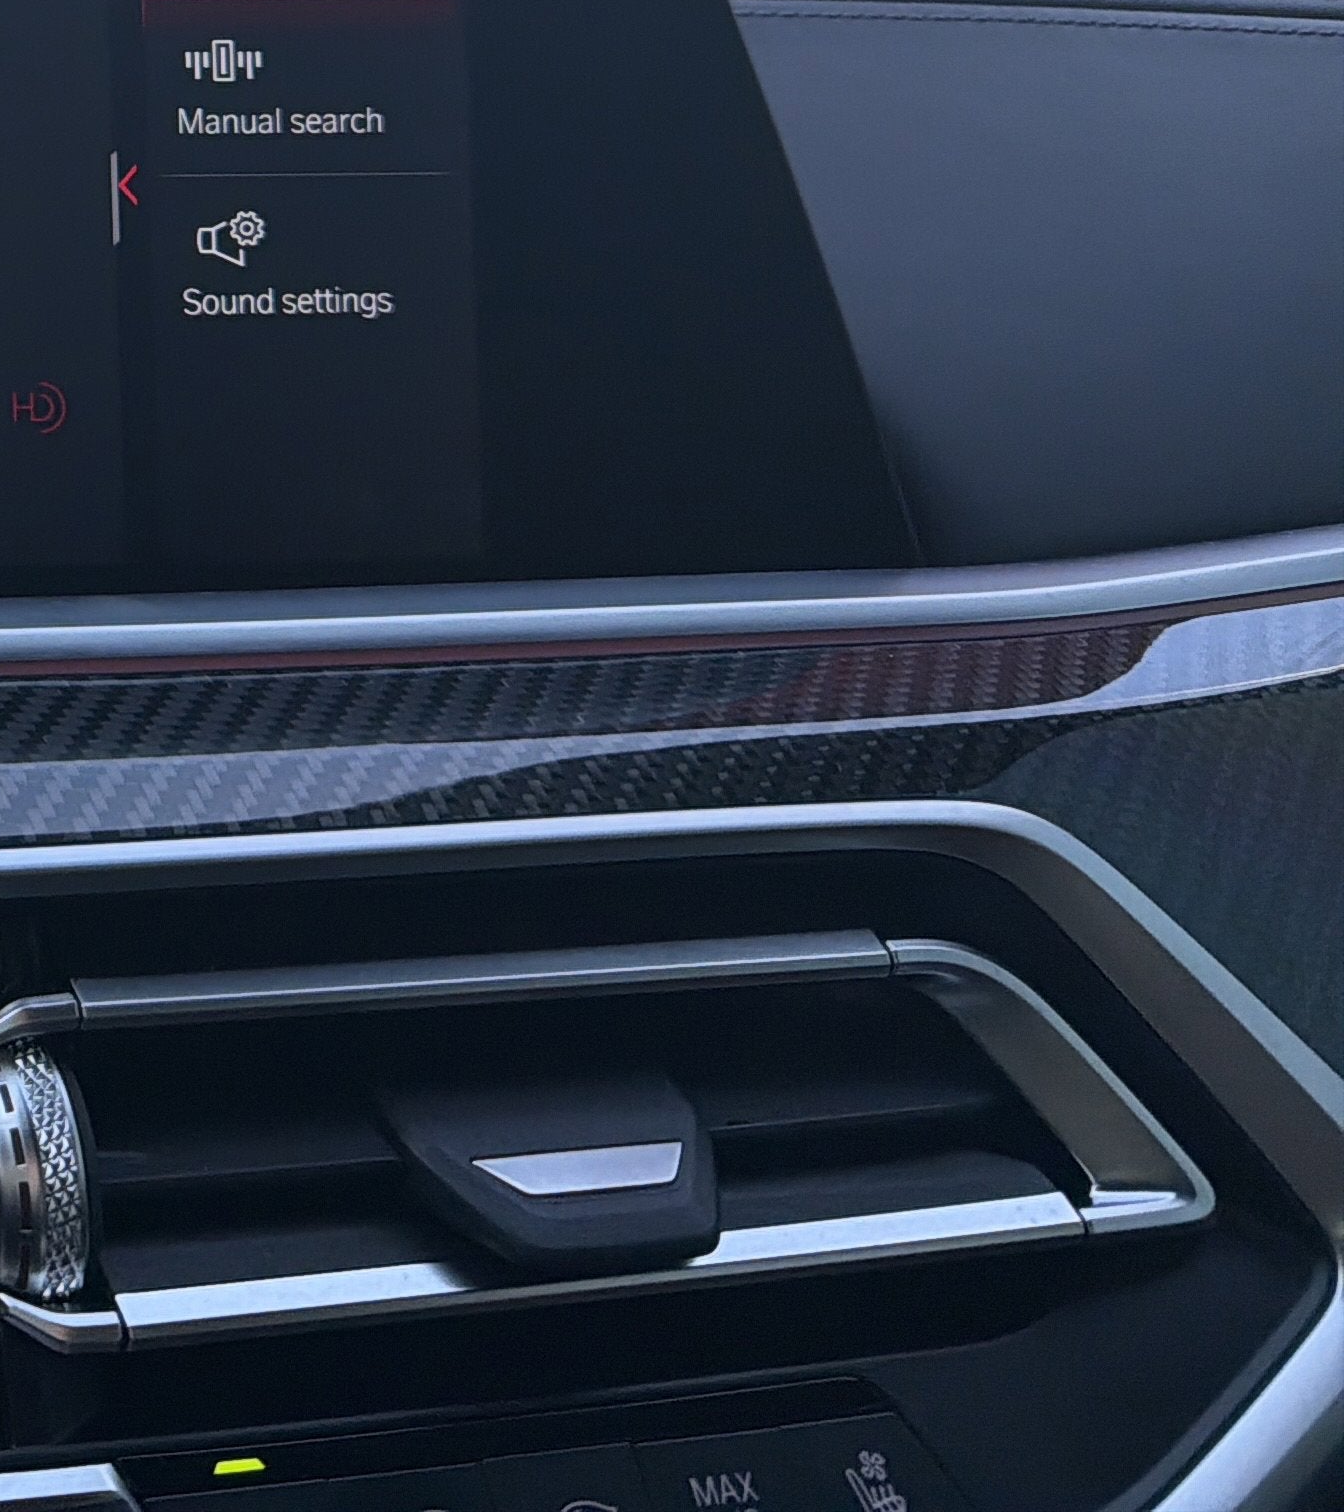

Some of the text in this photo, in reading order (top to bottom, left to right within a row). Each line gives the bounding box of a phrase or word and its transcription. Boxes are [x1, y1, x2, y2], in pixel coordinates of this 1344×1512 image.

[179, 107, 384, 134] Manual search
[183, 287, 393, 318] Sound settings
[689, 1472, 759, 1506] MAX
